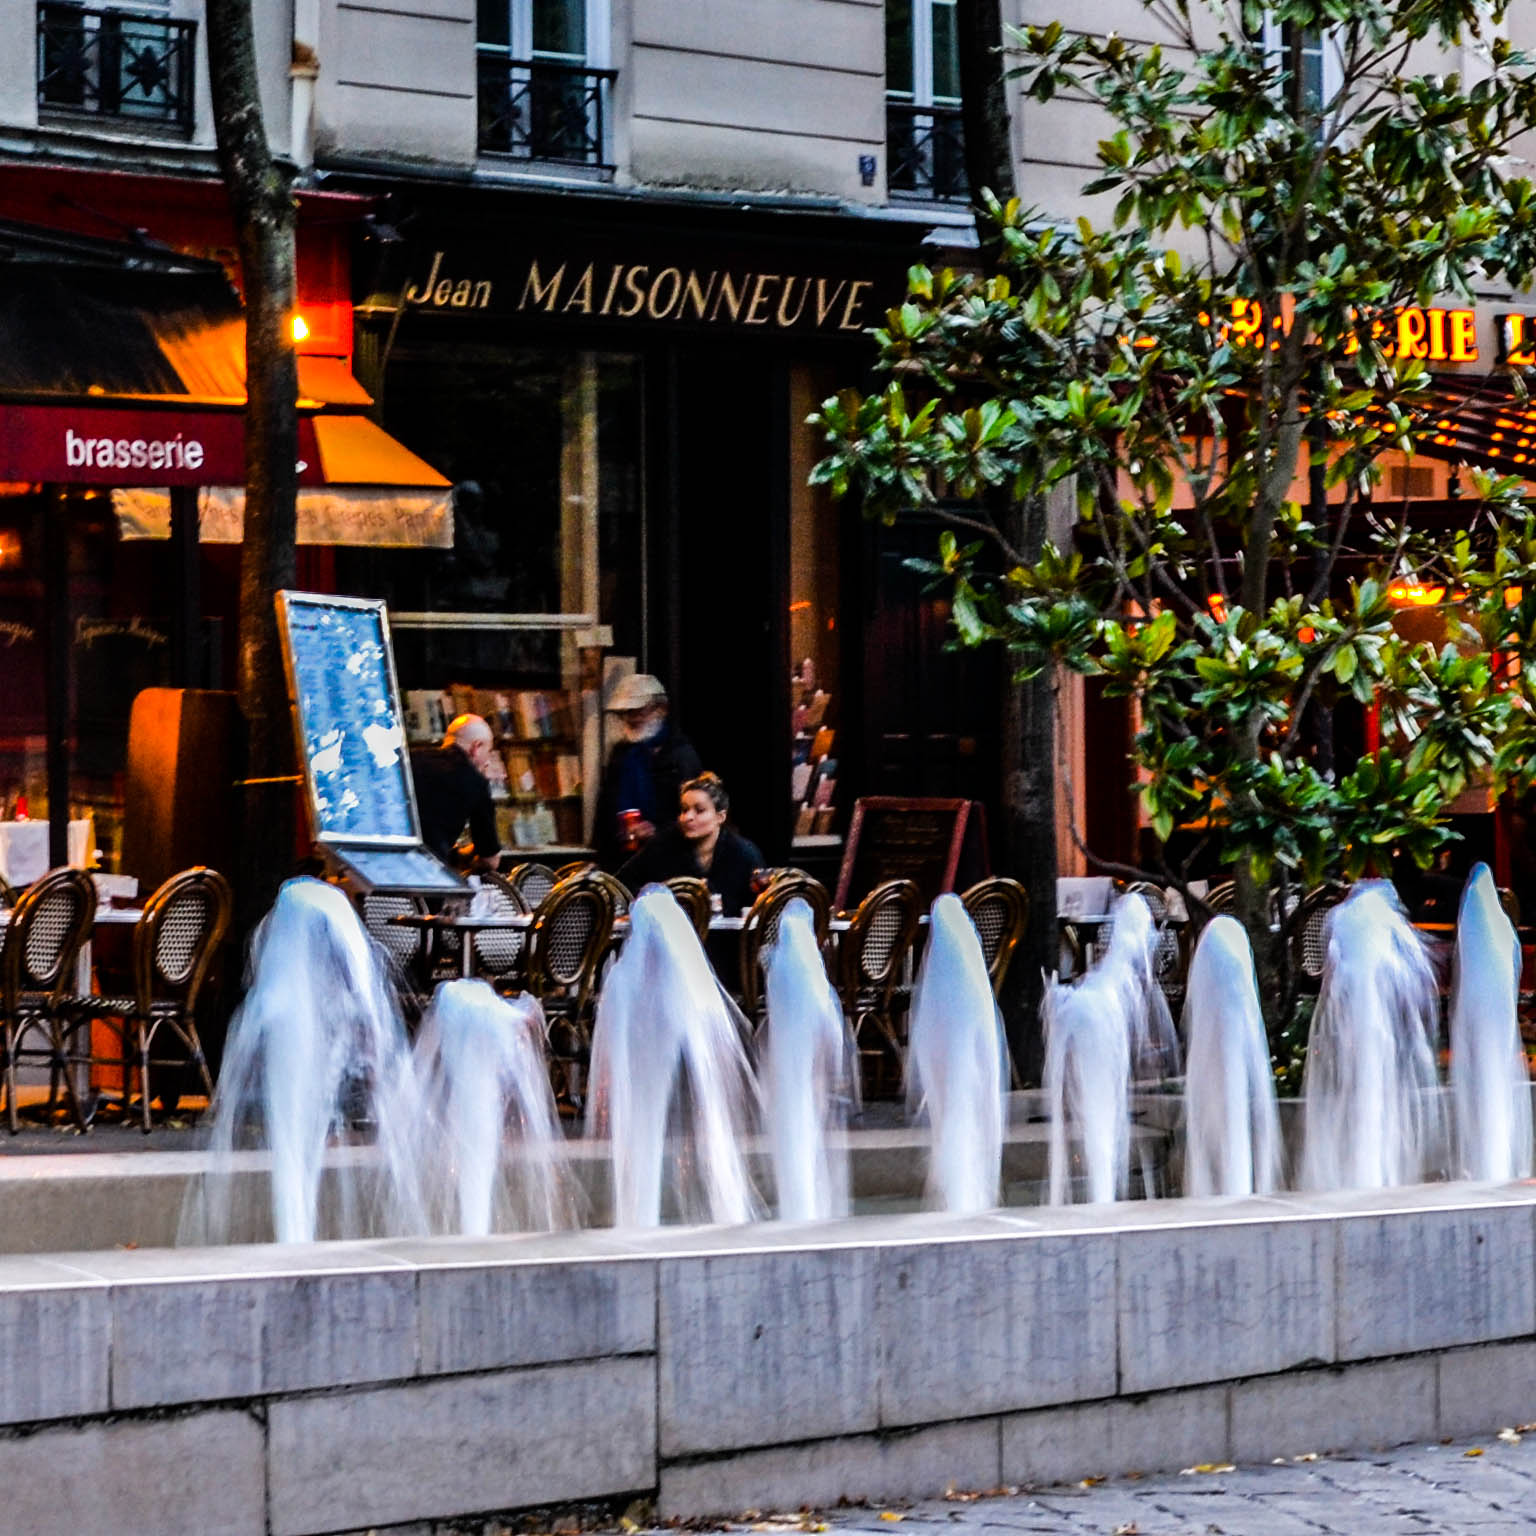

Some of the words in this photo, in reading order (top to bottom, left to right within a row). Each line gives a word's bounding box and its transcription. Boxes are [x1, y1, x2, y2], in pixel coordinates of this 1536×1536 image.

[406, 251, 494, 310] Jean
[517, 258, 874, 332] MAISONNEUVE
[65, 430, 204, 470] brasserie
